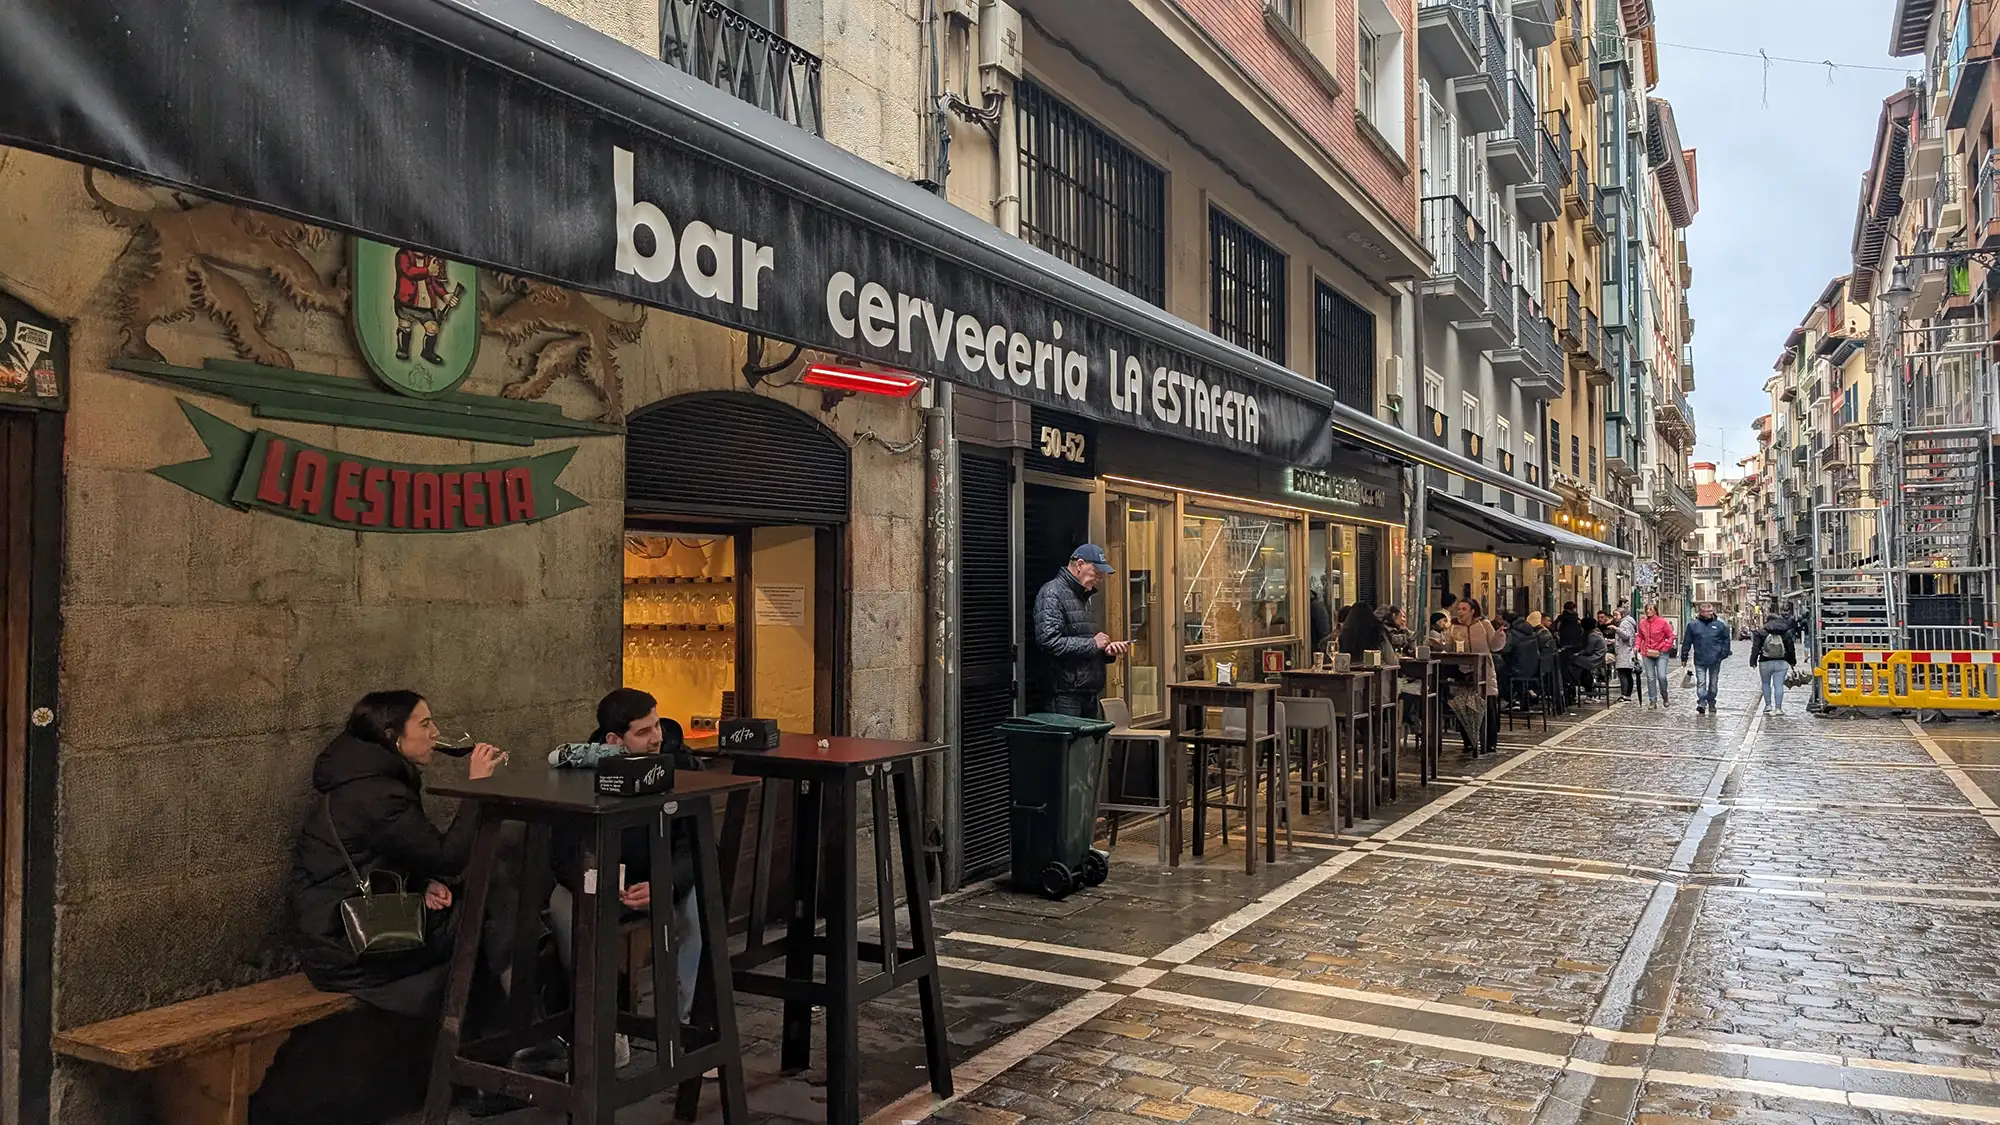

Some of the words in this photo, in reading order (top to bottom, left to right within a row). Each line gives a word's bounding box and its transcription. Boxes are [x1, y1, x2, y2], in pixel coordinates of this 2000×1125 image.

[614, 145, 774, 311] bar
[827, 271, 1088, 401] cerveceria
[1110, 348, 1143, 416] LA
[1152, 366, 1260, 445] ESTAFETA
[1041, 426, 1085, 463] 50-52
[257, 439, 328, 515] LA
[333, 460, 536, 529] ESTAFETA
[730, 727, 754, 744] 18/70
[643, 763, 665, 786] 18/70
